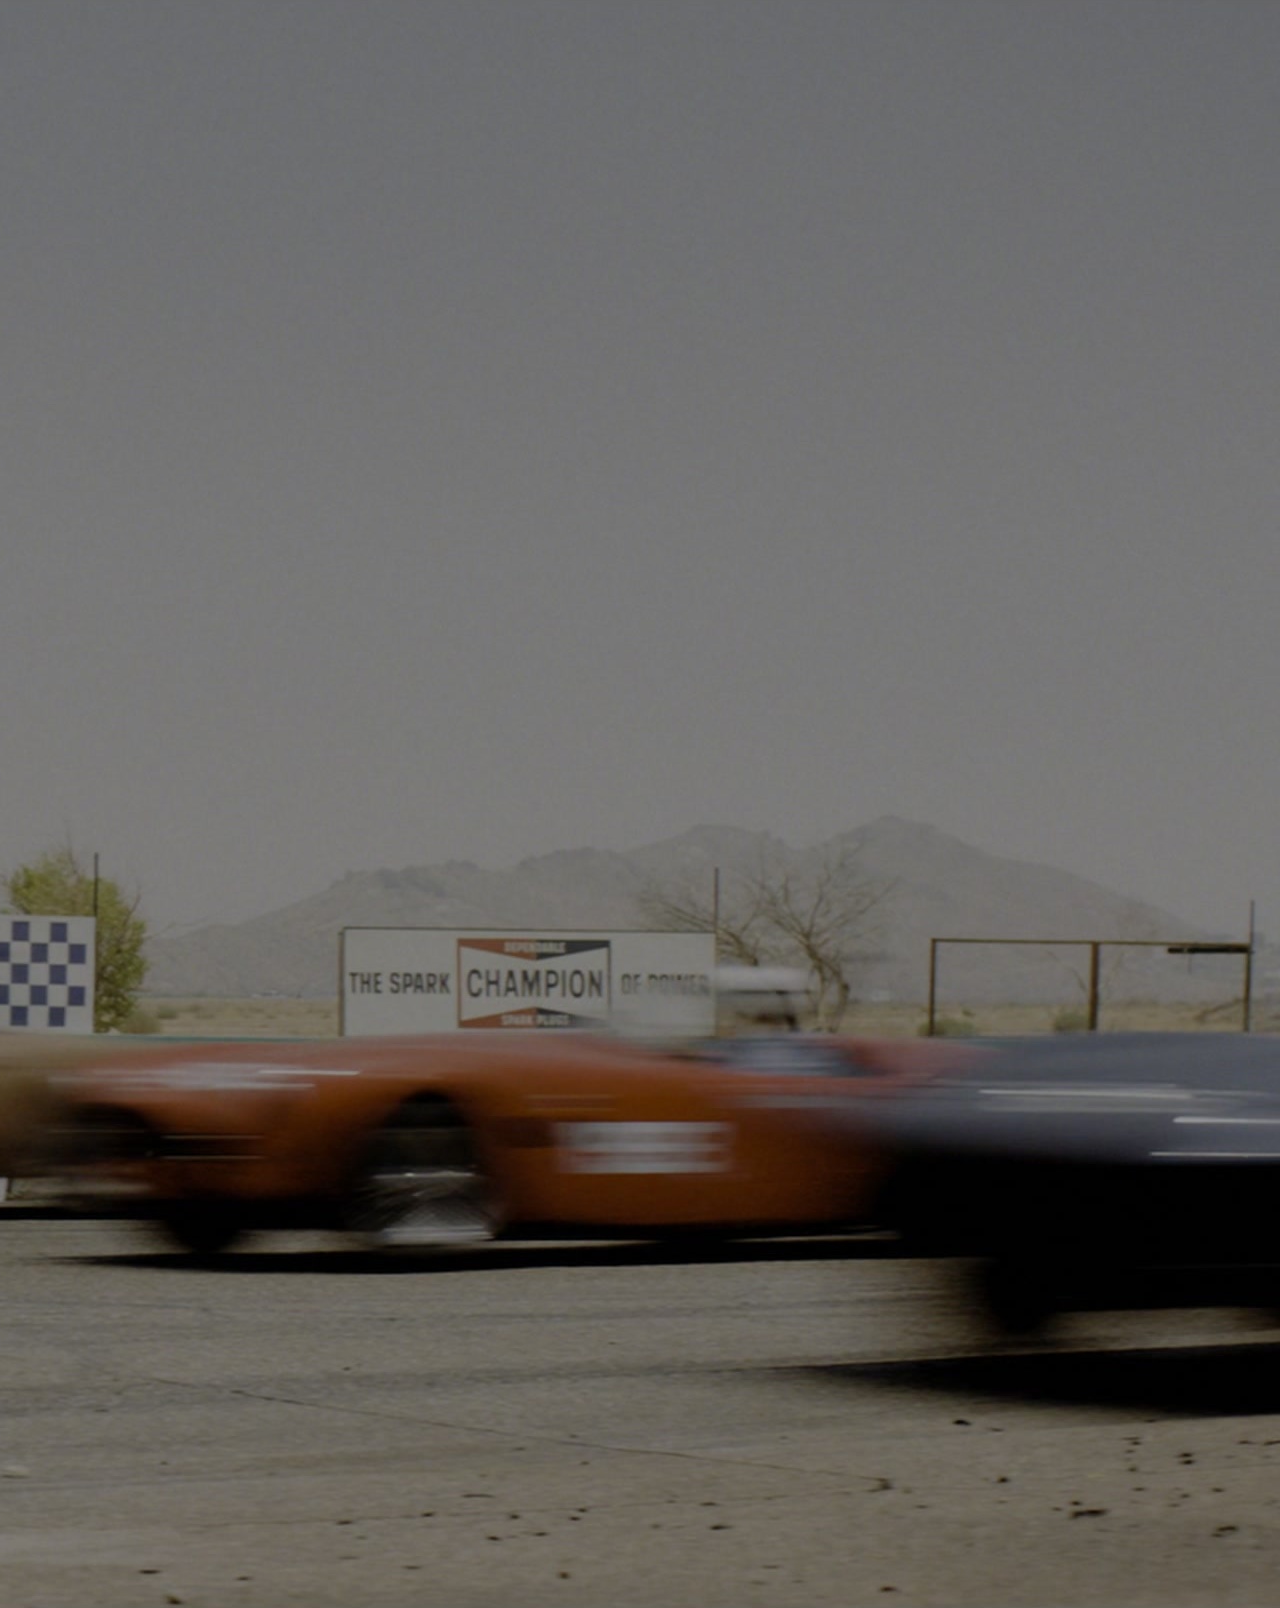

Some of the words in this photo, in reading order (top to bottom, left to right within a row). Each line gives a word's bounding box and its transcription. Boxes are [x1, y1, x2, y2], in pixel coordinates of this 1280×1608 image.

[349, 972, 382, 995] THE
[390, 972, 451, 995] SPARK
[467, 969, 603, 998] CHAMPION
[621, 974, 641, 995] OF
